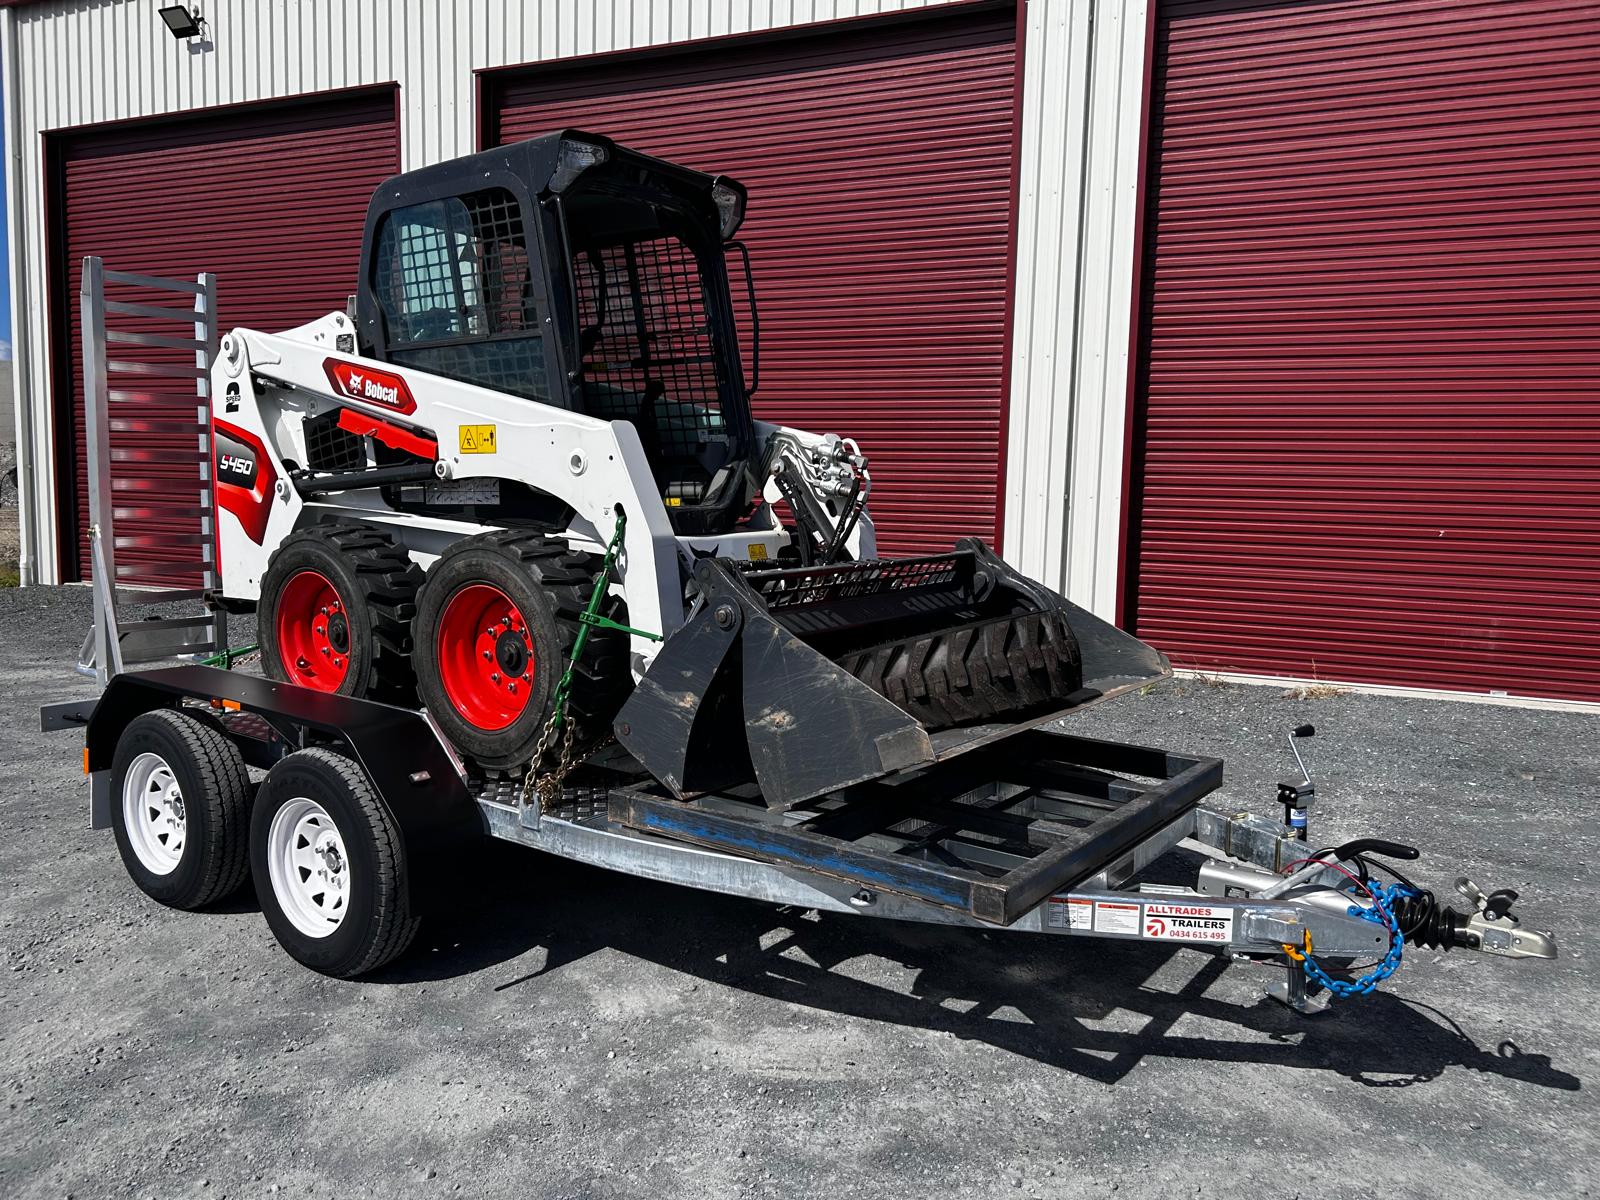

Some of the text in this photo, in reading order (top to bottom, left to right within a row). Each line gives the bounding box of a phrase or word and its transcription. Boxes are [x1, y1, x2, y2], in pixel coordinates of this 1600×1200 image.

[364, 379, 399, 404] Bobcat
[225, 394, 241, 403] SPEED
[220, 454, 253, 475] S450
[1147, 905, 1212, 916] ALLTRADES
[1170, 919, 1226, 929] TRAILERS
[1169, 929, 1226, 940] 0434 615 495
